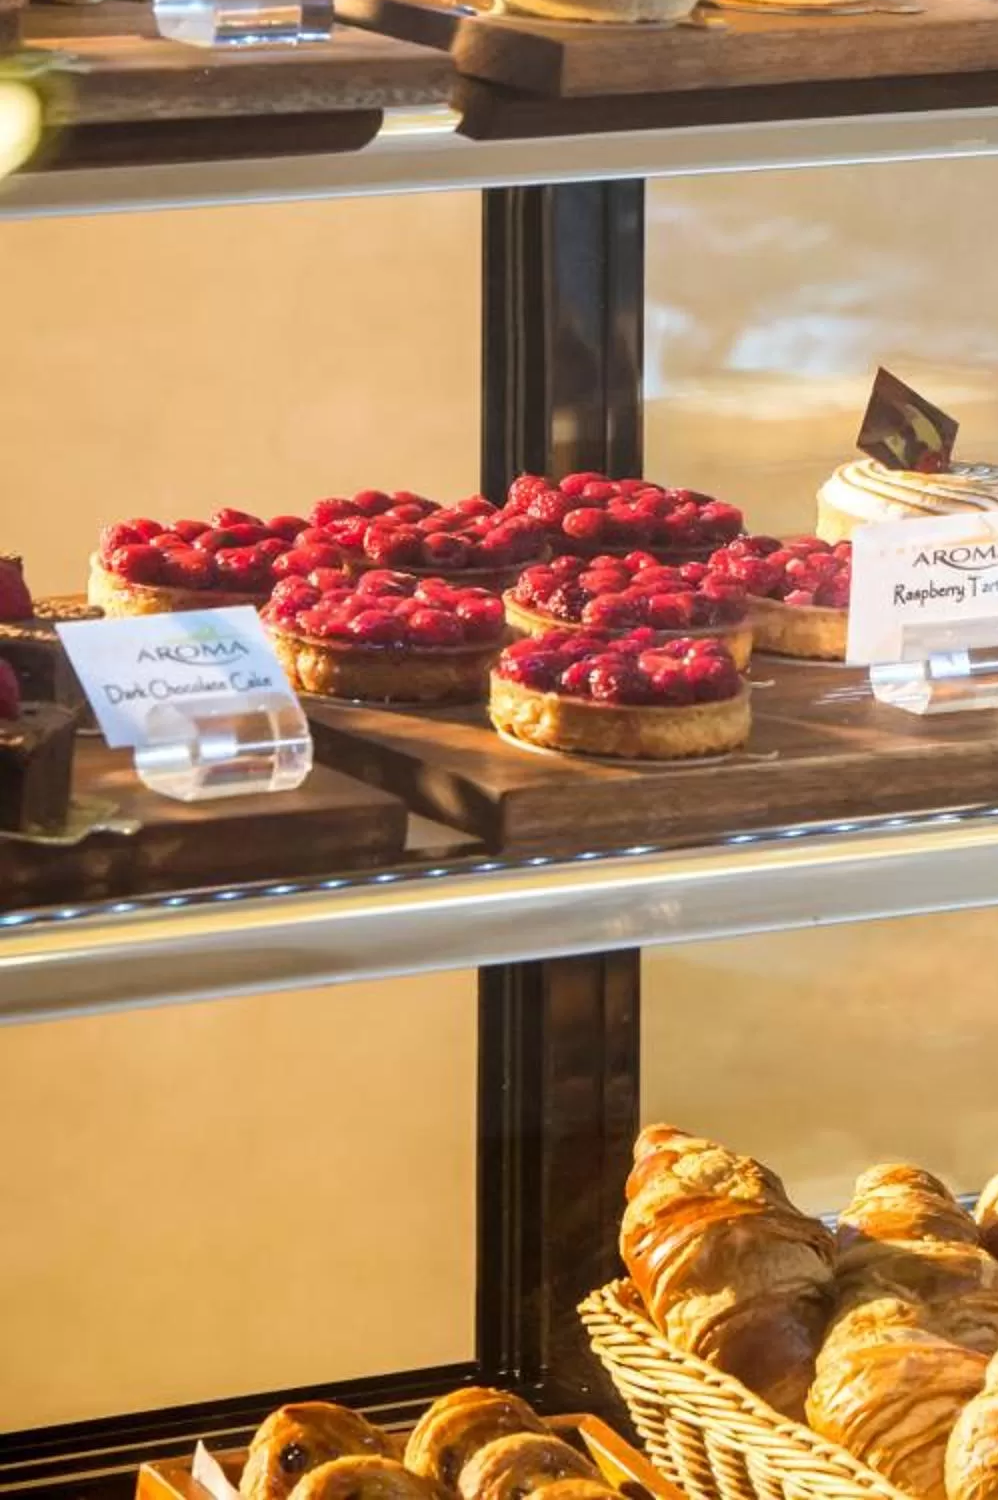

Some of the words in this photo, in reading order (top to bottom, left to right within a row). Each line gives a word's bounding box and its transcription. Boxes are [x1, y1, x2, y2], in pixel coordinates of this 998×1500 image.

[894, 579, 965, 608] Raspberry
[137, 640, 250, 666] AROMA
[102, 682, 148, 705] Dark
[229, 671, 273, 692] Cake
